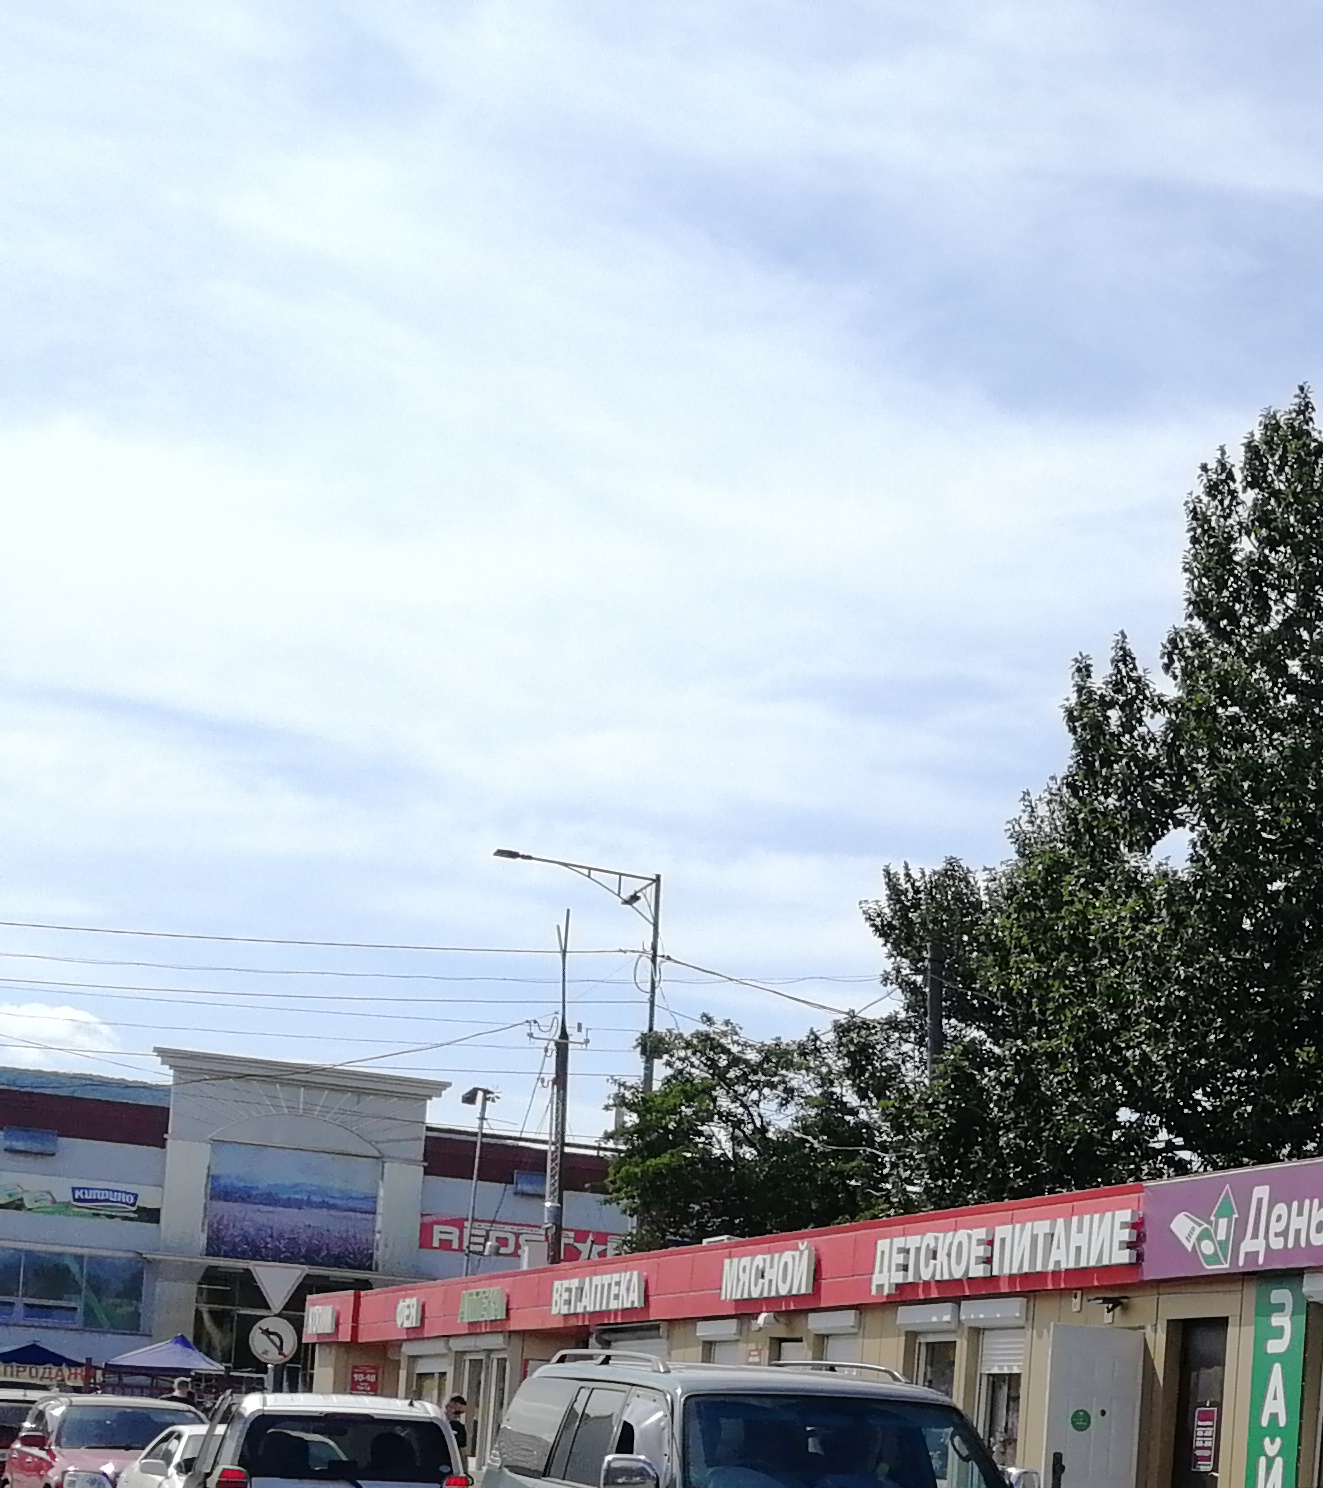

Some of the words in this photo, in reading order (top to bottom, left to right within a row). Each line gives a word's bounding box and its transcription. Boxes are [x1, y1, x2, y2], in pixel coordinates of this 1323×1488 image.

[721, 1241, 814, 1300] МЯСНОЙ
[871, 1228, 990, 1295] ДЕТСКОЕ
[992, 1209, 1137, 1276] ПИТАНИЕ
[551, 1271, 644, 1315] ВЕТ.АПТЕКА
